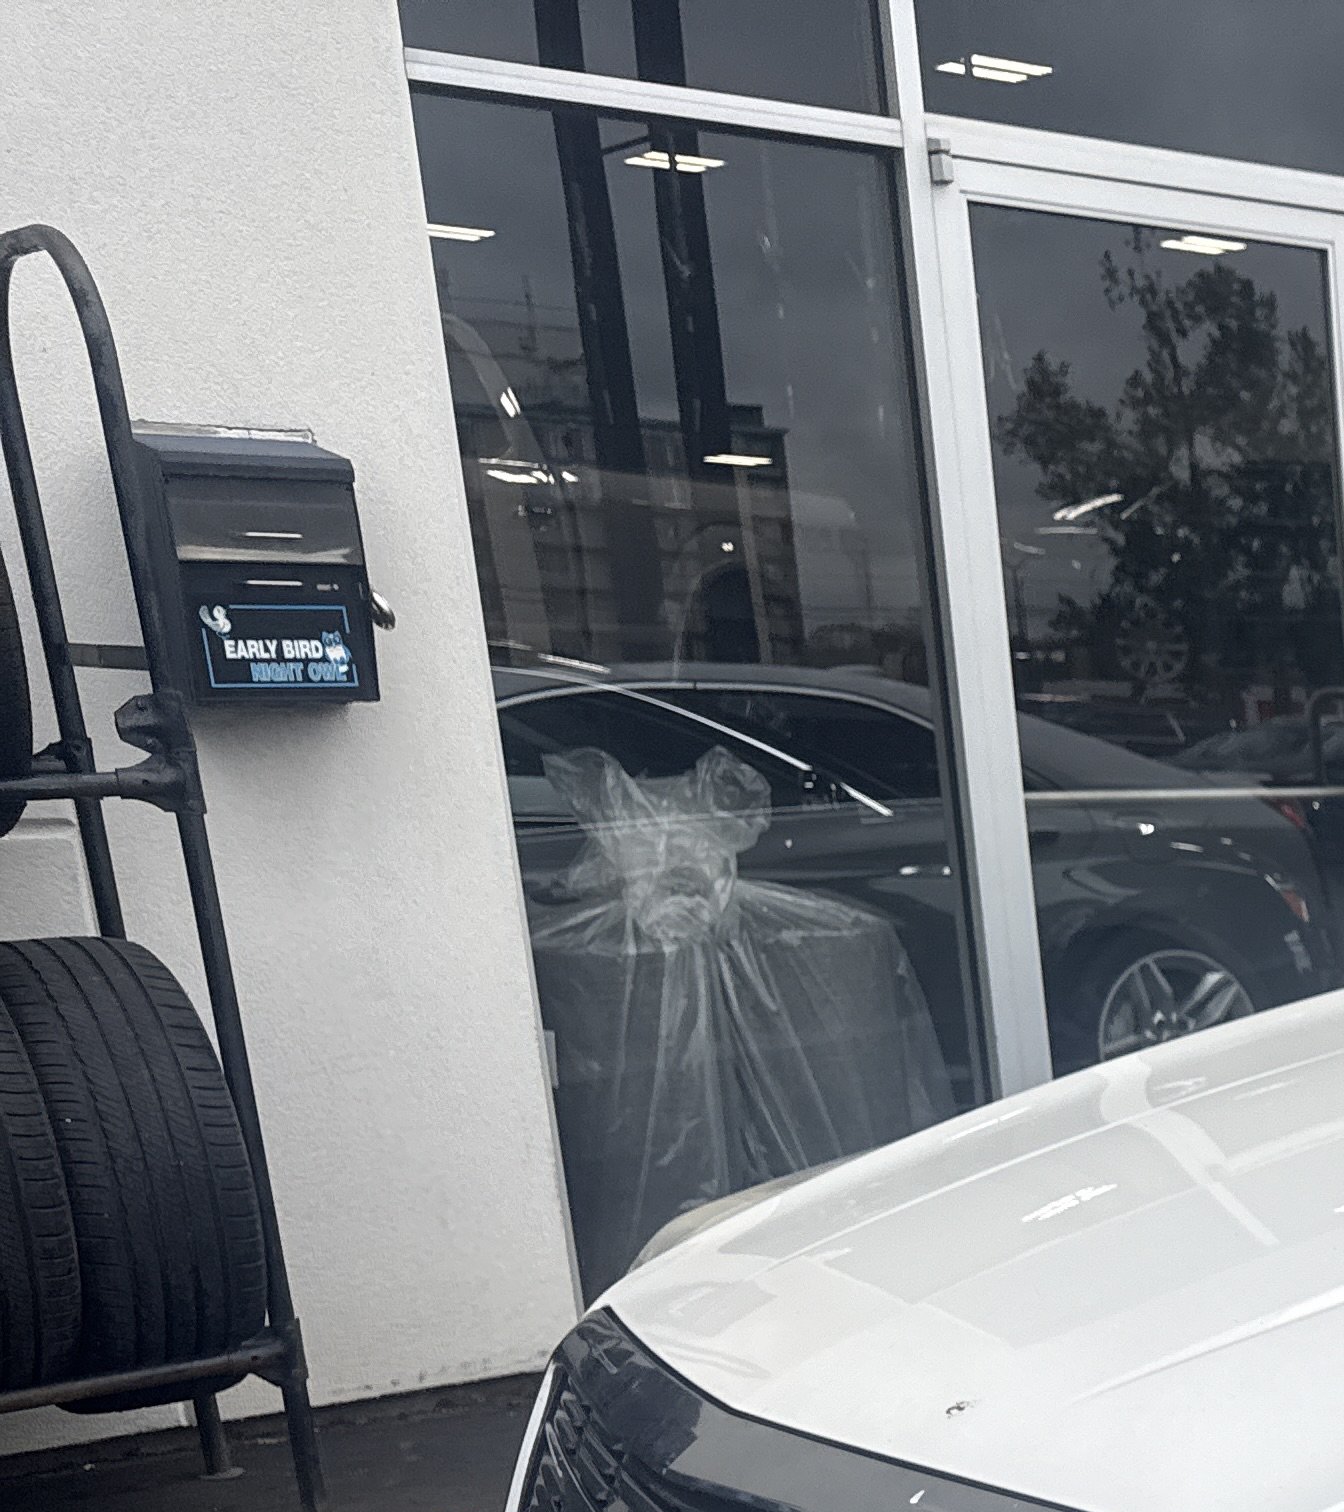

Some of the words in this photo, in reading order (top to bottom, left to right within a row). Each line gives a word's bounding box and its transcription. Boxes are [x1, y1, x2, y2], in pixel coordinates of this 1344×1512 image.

[224, 639, 277, 659] EARLY
[281, 639, 323, 659] BIRD
[250, 662, 304, 682] NIGHT
